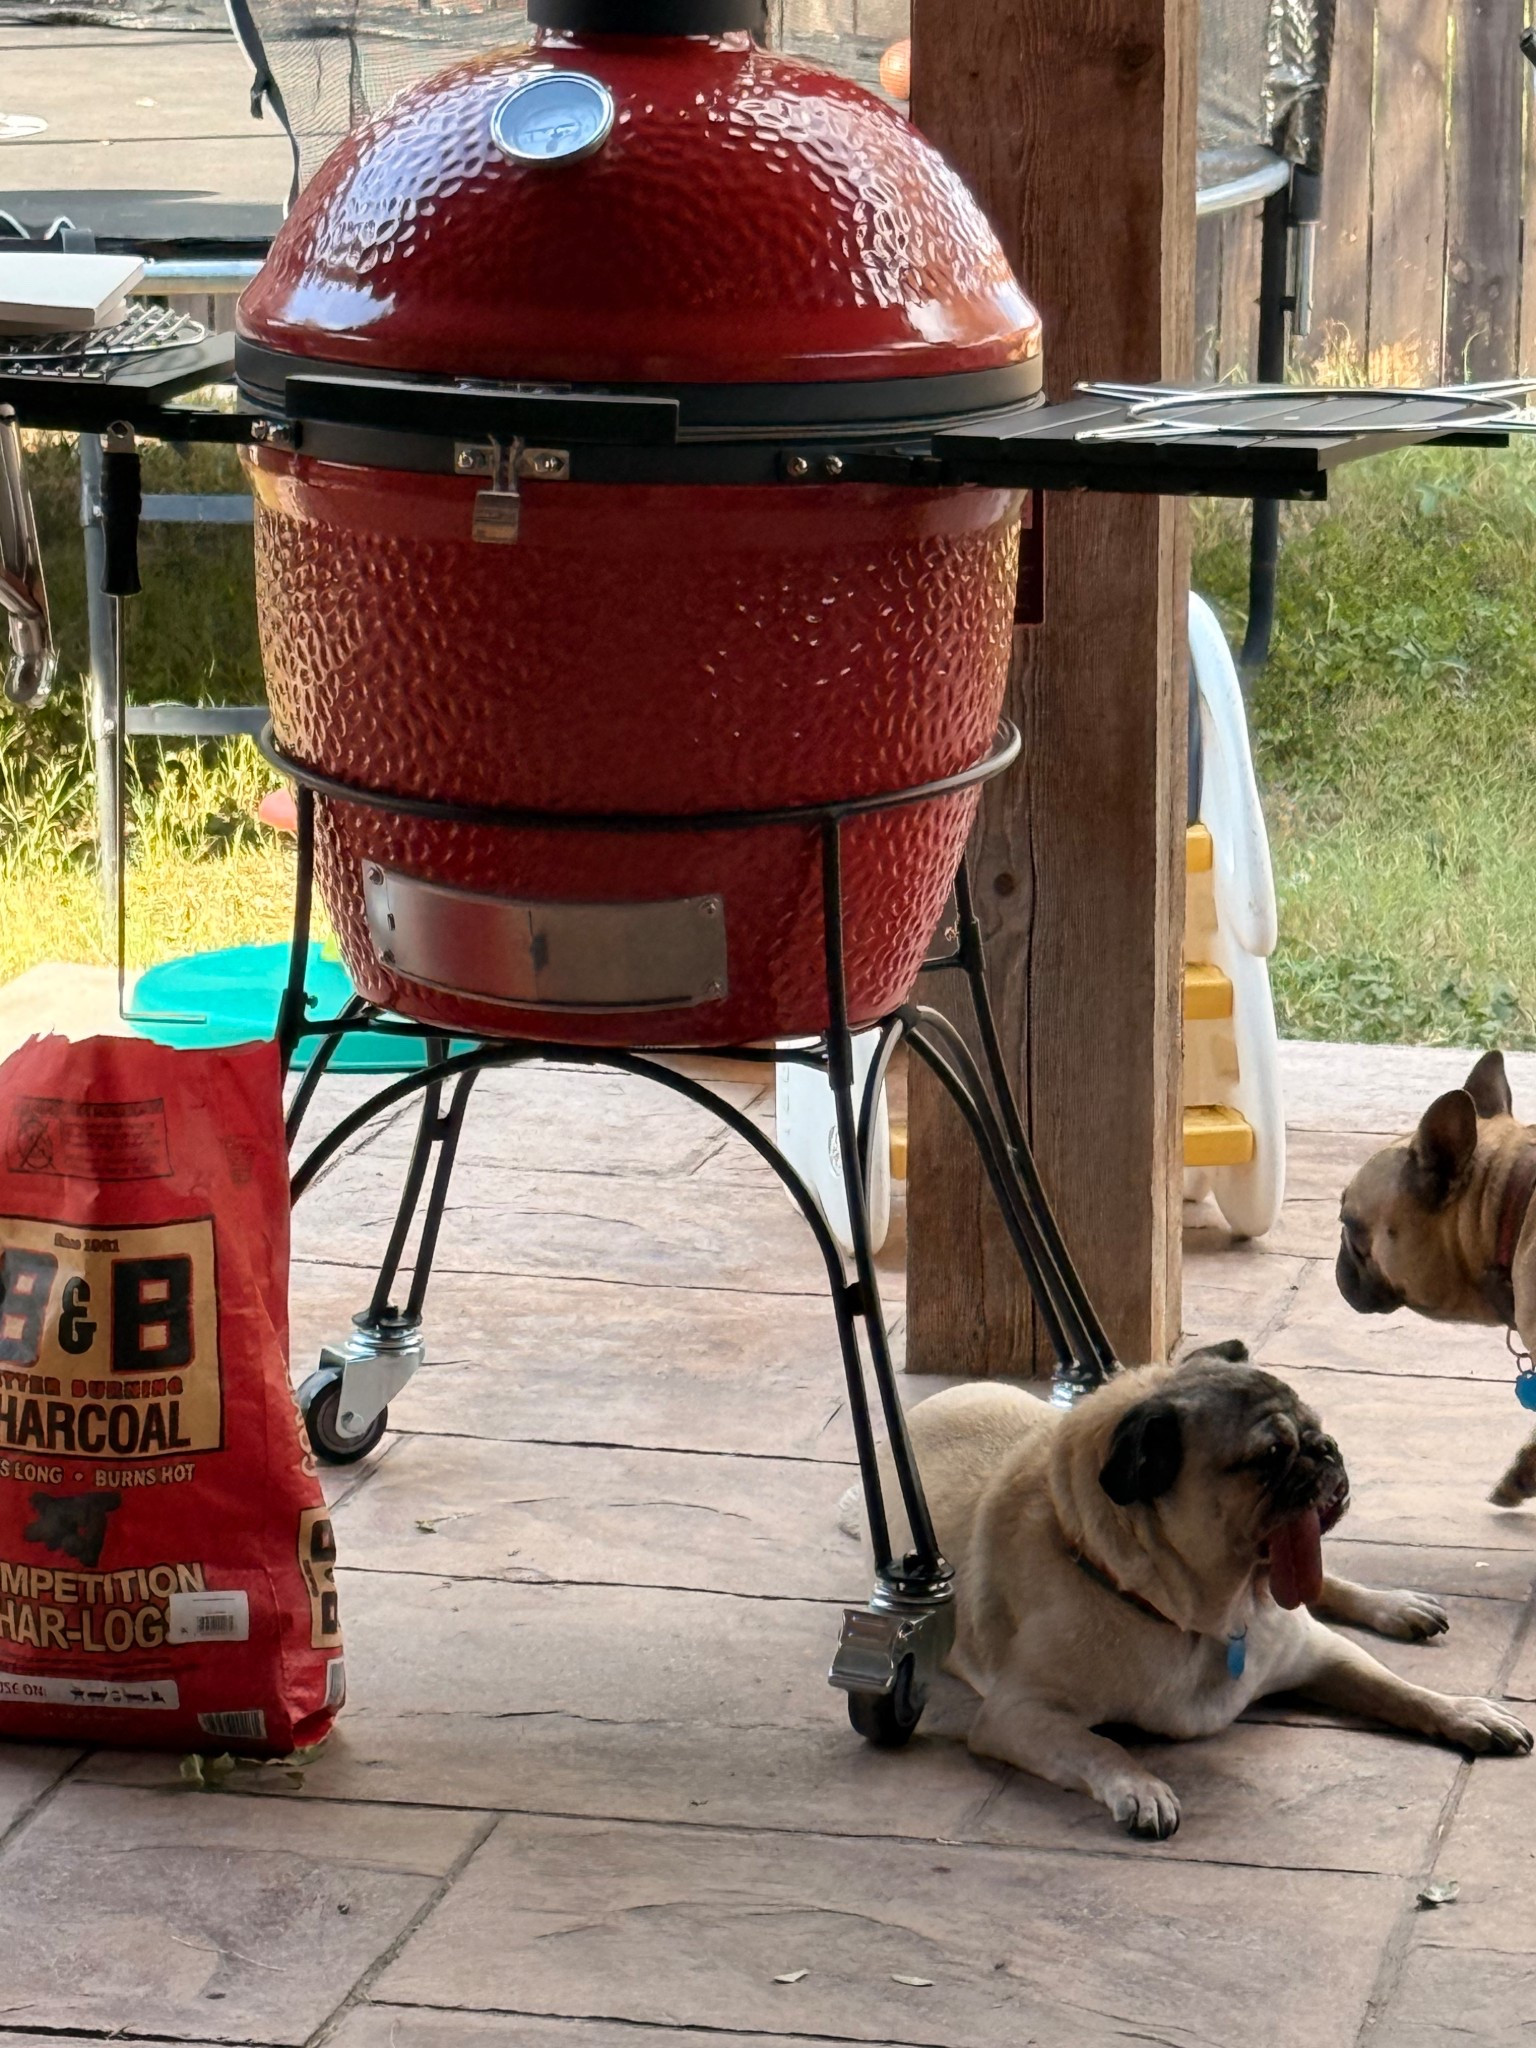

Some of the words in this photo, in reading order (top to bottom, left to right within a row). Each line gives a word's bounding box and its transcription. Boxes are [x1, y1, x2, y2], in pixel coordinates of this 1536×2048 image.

[59, 1276, 97, 1354] &
[110, 1253, 195, 1374] B
[0, 1370, 61, 1396] TTER
[71, 1376, 183, 1400] BURNING
[14, 1461, 64, 1484] LONG
[95, 1468, 157, 1488] BURNS
[161, 1463, 195, 1484] HOT
[0, 1600, 171, 1652] HAR-LOG
